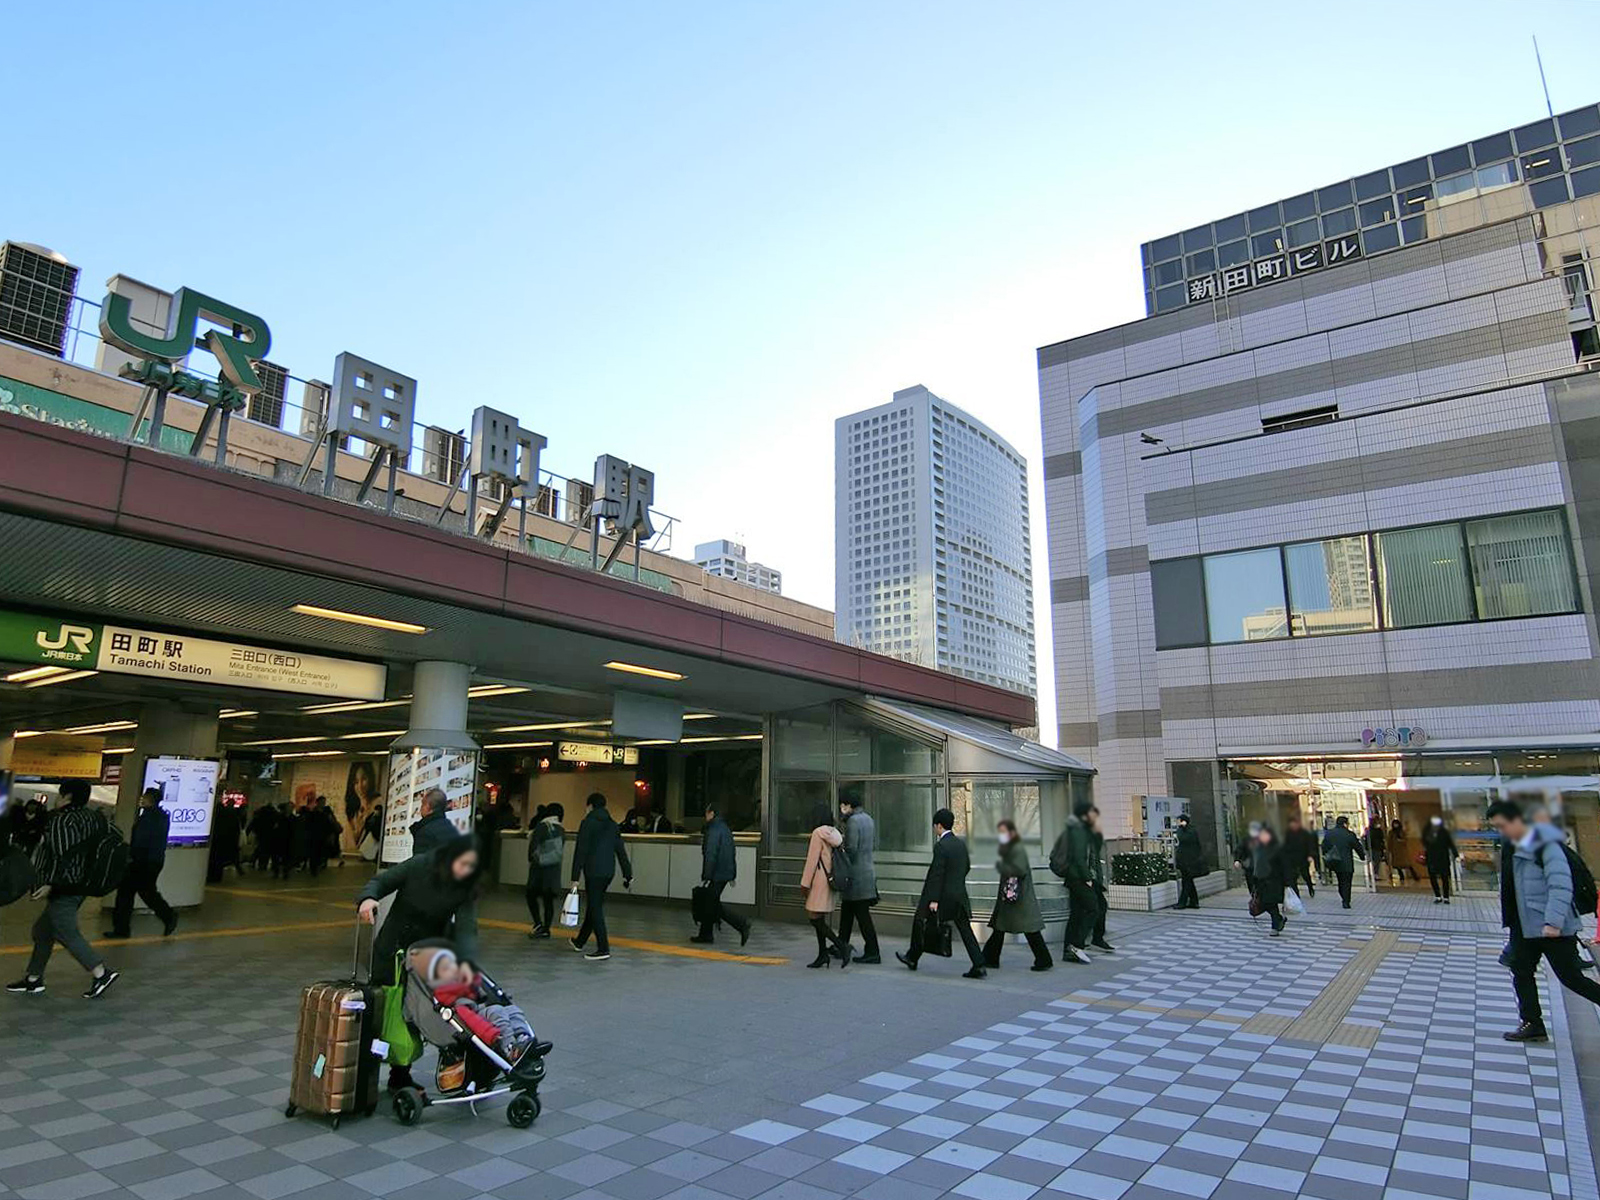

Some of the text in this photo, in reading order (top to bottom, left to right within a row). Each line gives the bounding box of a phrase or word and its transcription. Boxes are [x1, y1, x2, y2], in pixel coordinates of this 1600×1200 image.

[1189, 239, 1358, 300] 新田町ビル
[99, 285, 656, 539] JR 田町駅
[36, 624, 94, 654] JR
[110, 632, 184, 658] 田町駅
[41, 650, 83, 662] JR東日本
[110, 653, 212, 676] Tamachi Station
[229, 661, 244, 670] Mita
[246, 663, 277, 674] Entrance
[278, 667, 298, 677] (West
[299, 670, 331, 681] Entrance)
[172, 808, 206, 823] RISO
